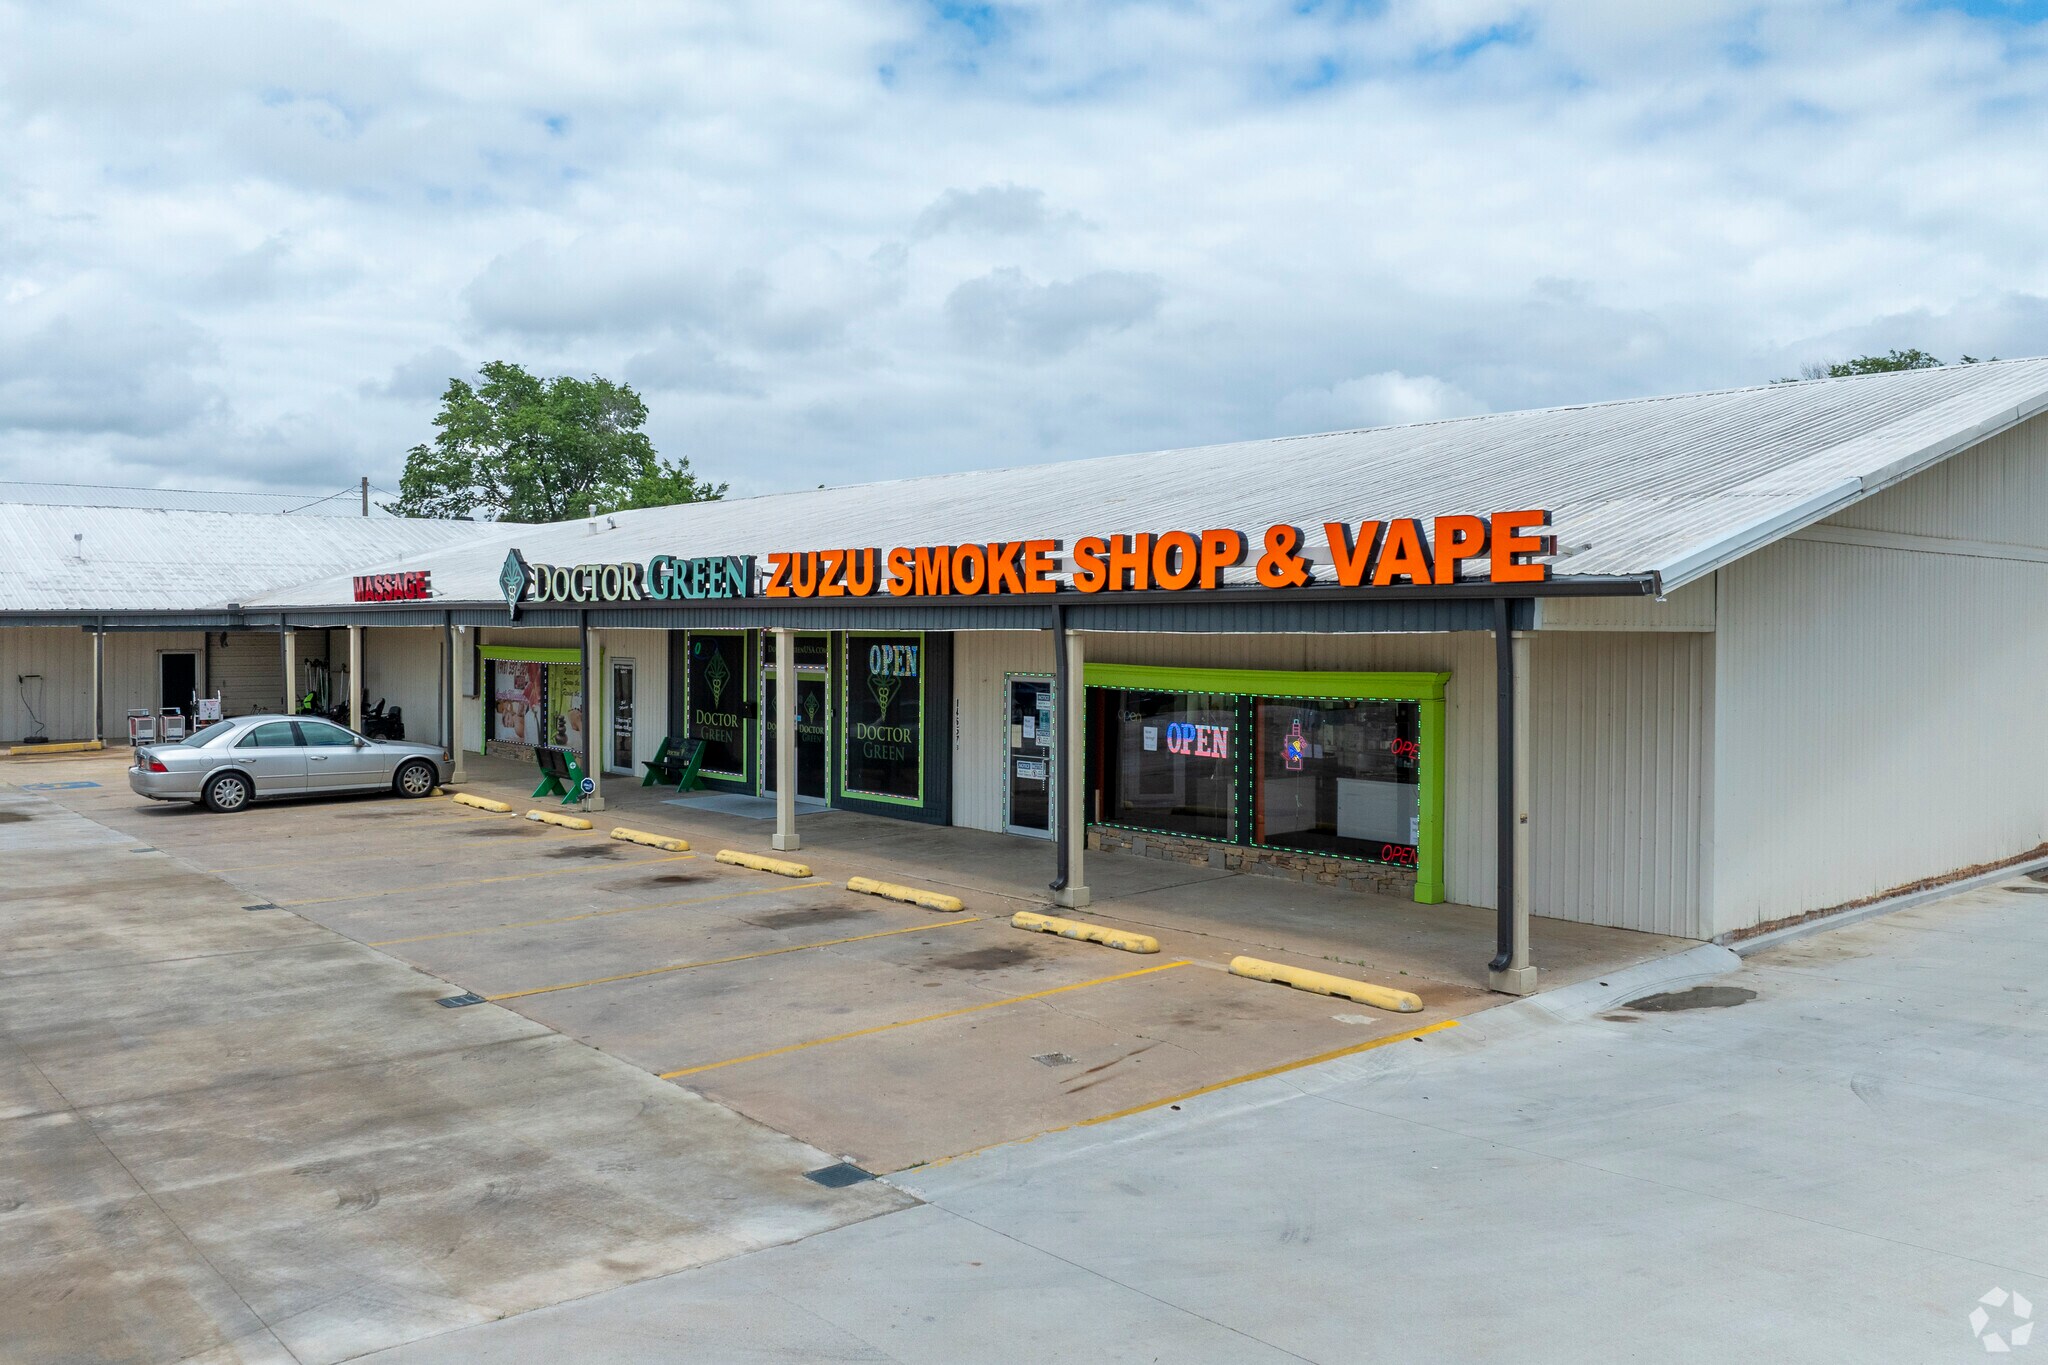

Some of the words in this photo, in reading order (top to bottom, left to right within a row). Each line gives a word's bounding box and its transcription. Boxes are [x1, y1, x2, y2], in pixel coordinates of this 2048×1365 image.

[766, 549, 880, 598] ZUZU
[887, 539, 1060, 596] SMOKE
[1073, 529, 1244, 592] SHOP
[1256, 524, 1312, 588] &
[1323, 510, 1550, 587] VAPE
[353, 571, 429, 602] MASSAGE
[532, 562, 642, 602] DOCTOR
[647, 555, 756, 600] GREEN
[869, 644, 918, 677] OPEN
[696, 709, 738, 728] DOCTOR
[857, 722, 912, 744] DOCTOR
[863, 742, 905, 761] GREEN
[1166, 722, 1229, 759] OPEN
[1391, 737, 1421, 760] OPE
